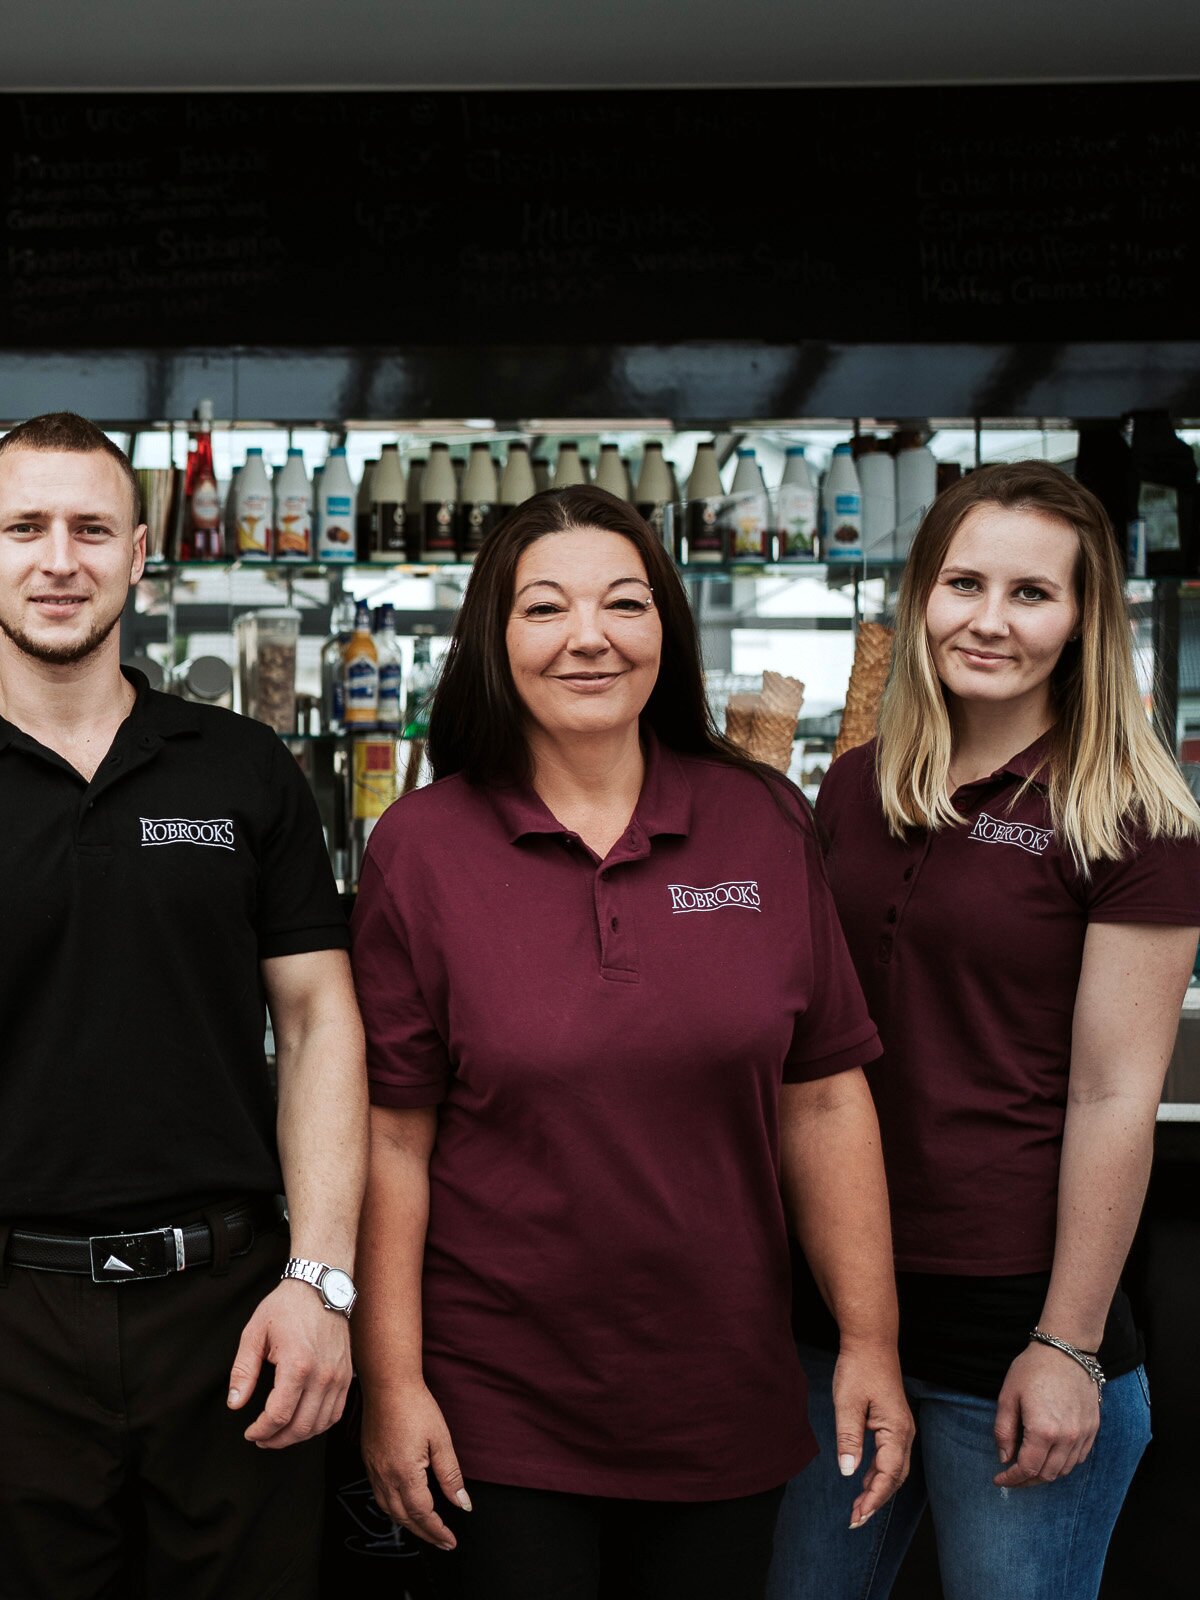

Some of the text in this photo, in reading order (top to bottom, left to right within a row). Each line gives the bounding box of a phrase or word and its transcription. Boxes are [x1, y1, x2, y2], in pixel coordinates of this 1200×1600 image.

[140, 819, 234, 845] ROBROOKS
[970, 813, 1055, 851] ROBROOKS
[668, 883, 761, 909] ROBROOKS
